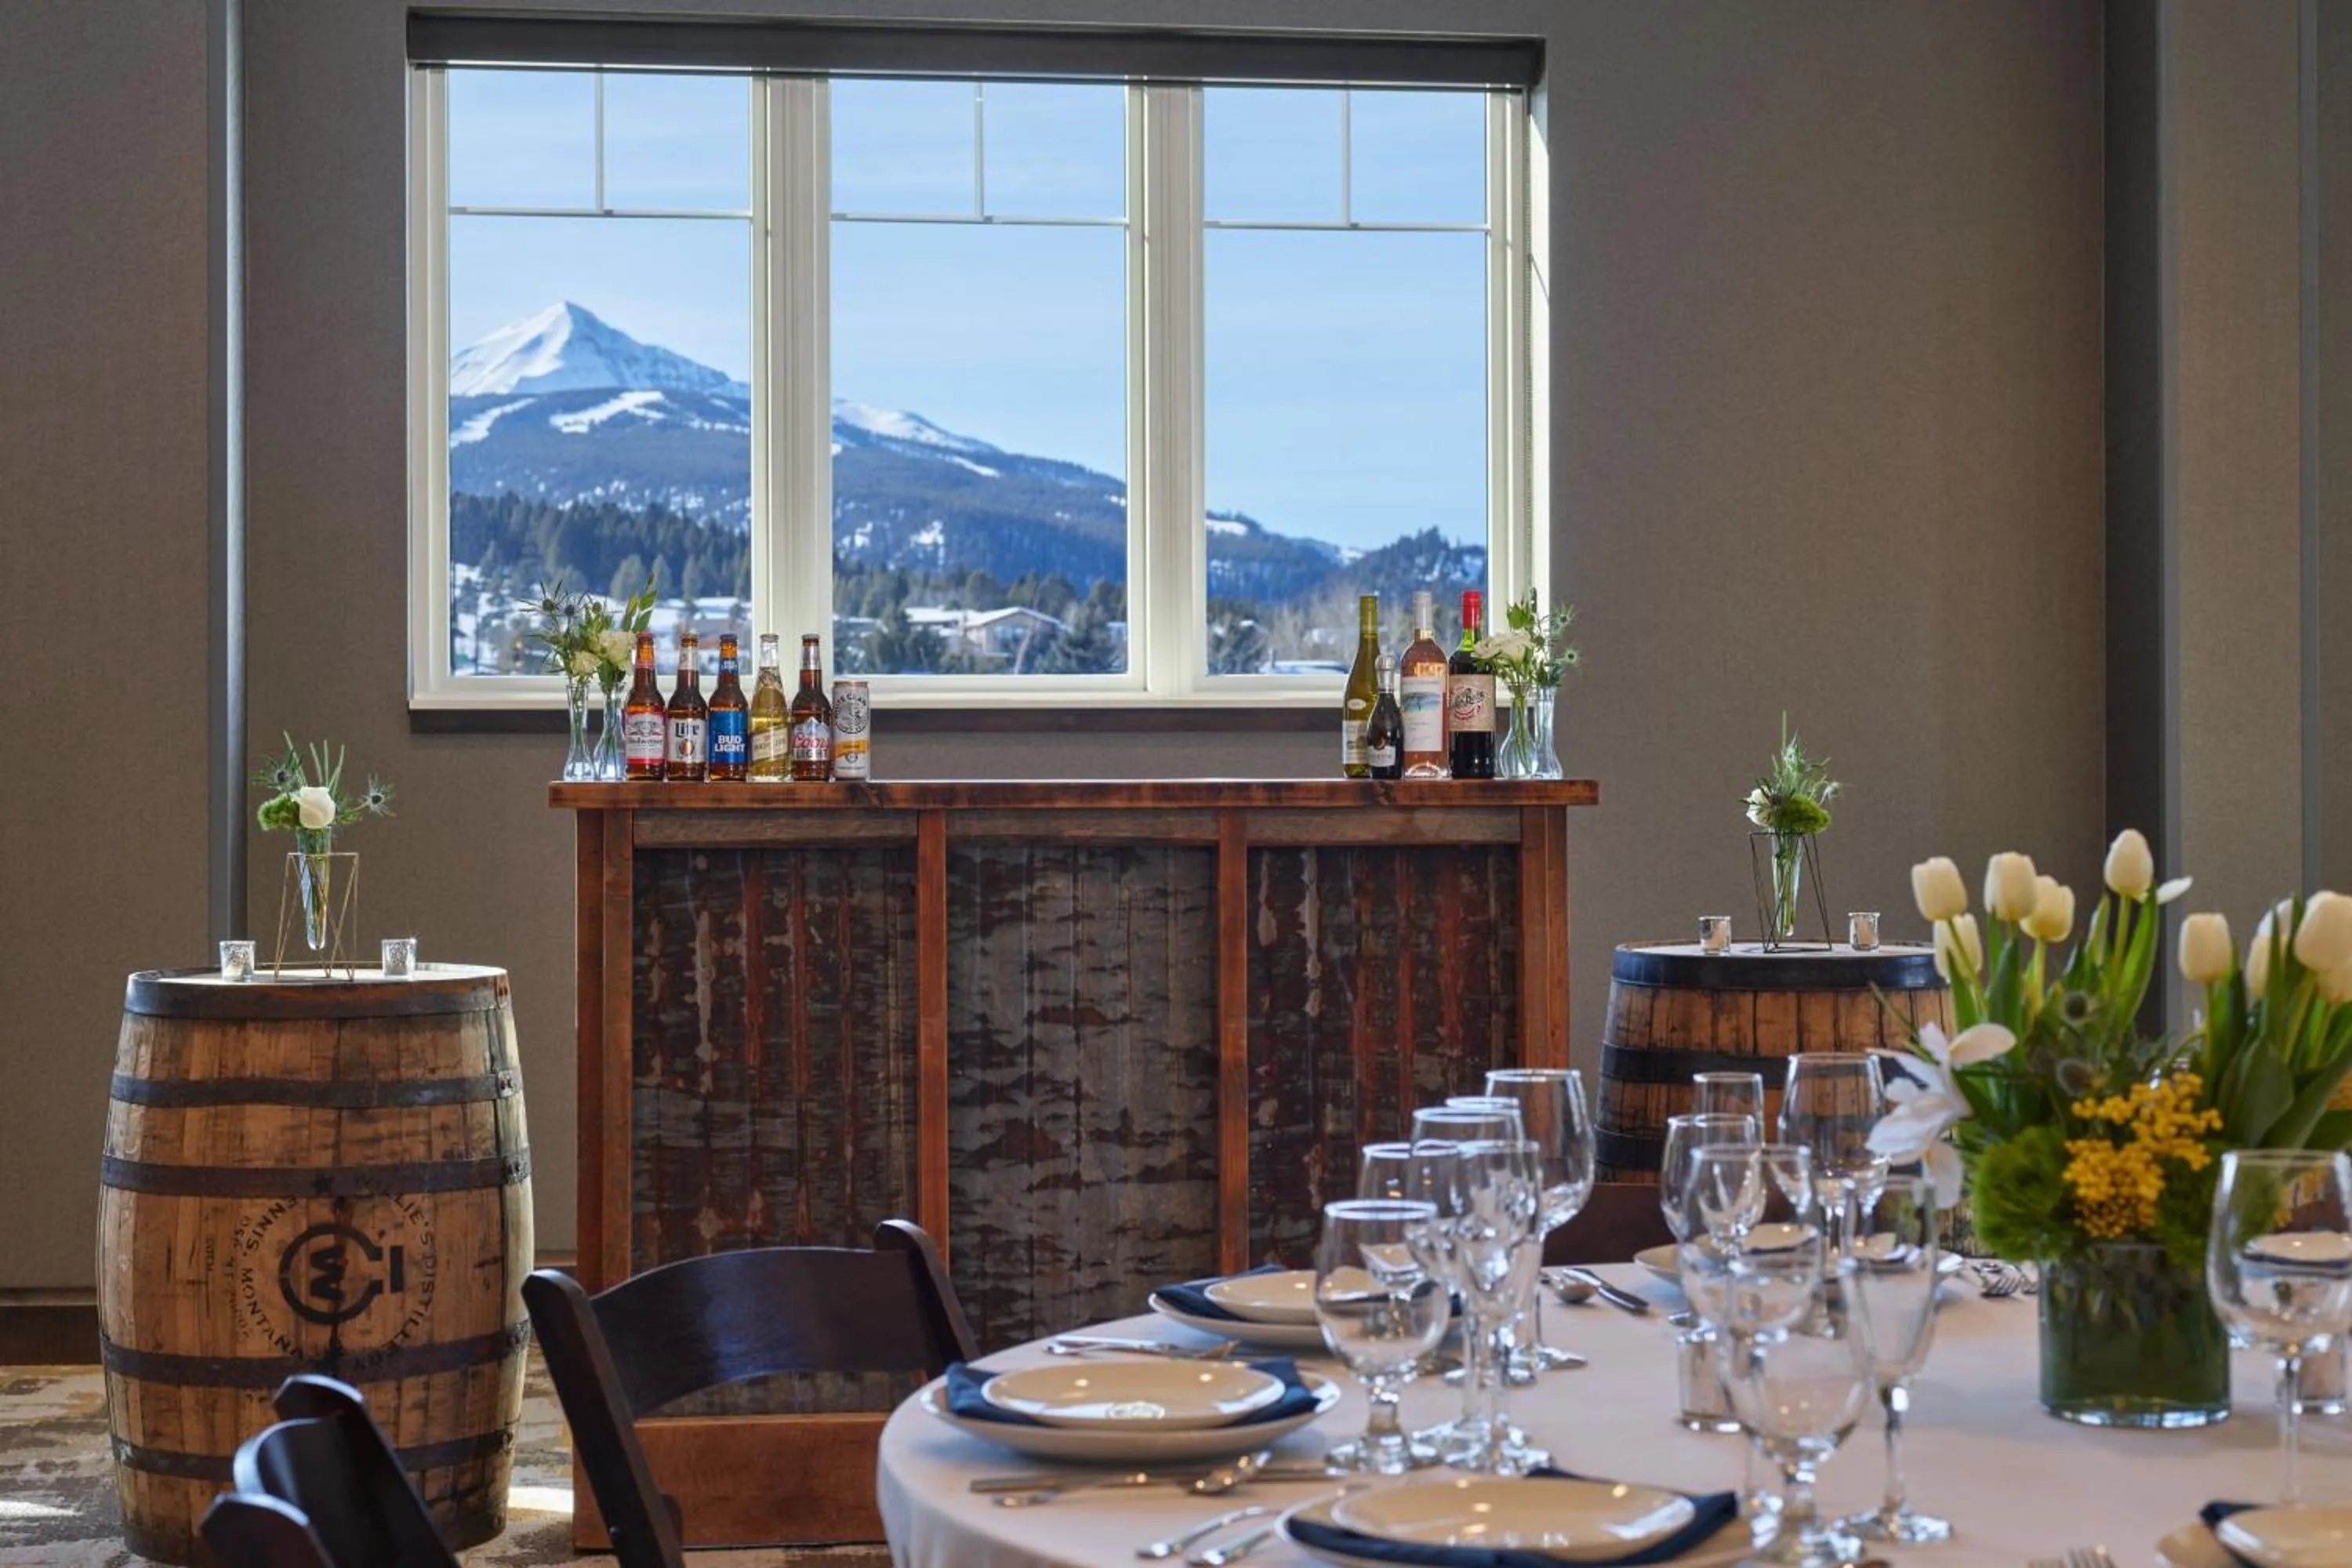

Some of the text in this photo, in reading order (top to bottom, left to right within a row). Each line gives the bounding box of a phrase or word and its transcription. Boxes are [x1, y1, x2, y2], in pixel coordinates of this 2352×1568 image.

[717, 735, 741, 744] BUD
[714, 743, 745, 753] LIGHT
[796, 749, 829, 758] LIGHT
